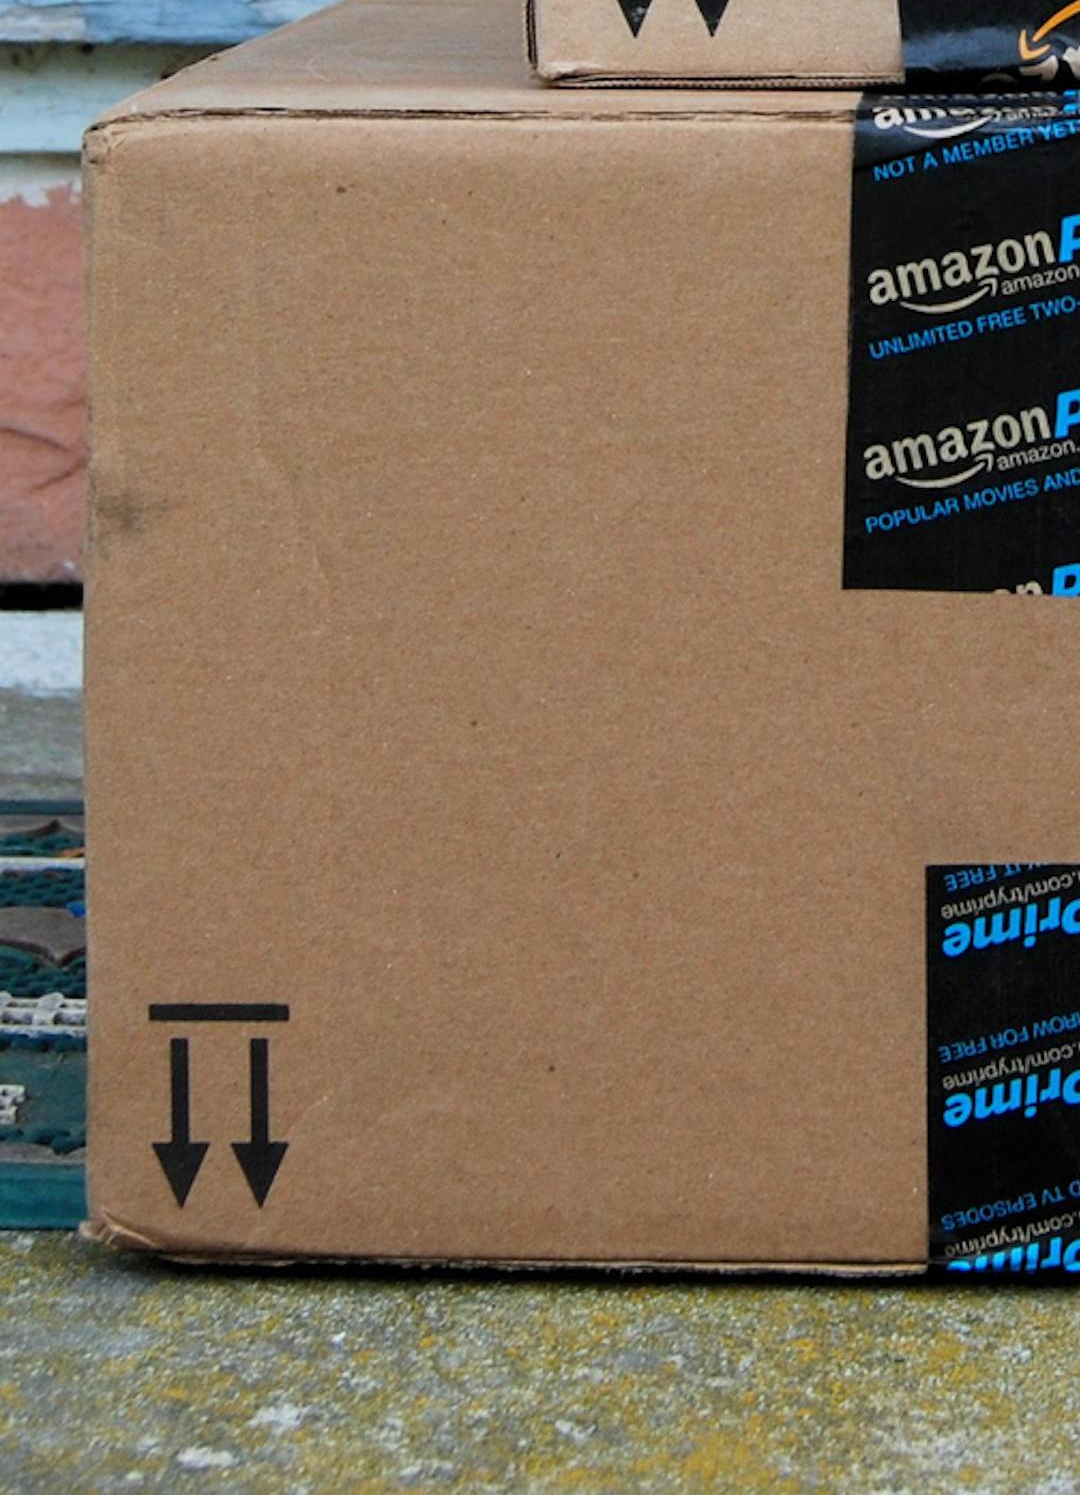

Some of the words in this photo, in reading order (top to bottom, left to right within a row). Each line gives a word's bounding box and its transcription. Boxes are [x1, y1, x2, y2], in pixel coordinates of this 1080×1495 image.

[873, 156, 915, 182] NOT
[923, 151, 939, 170] A
[942, 129, 1034, 165] MEMBER
[869, 320, 973, 359] UNLIMITED
[976, 306, 1026, 334] FREE
[865, 496, 960, 533] POPULAR
[963, 477, 1039, 509] MOVIES
[943, 863, 997, 892] FREE
[938, 1036, 988, 1063] FREE
[990, 1025, 1029, 1050] FOR
[941, 1192, 1037, 1232] EPISODES
[1042, 1185, 1066, 1205] TV
